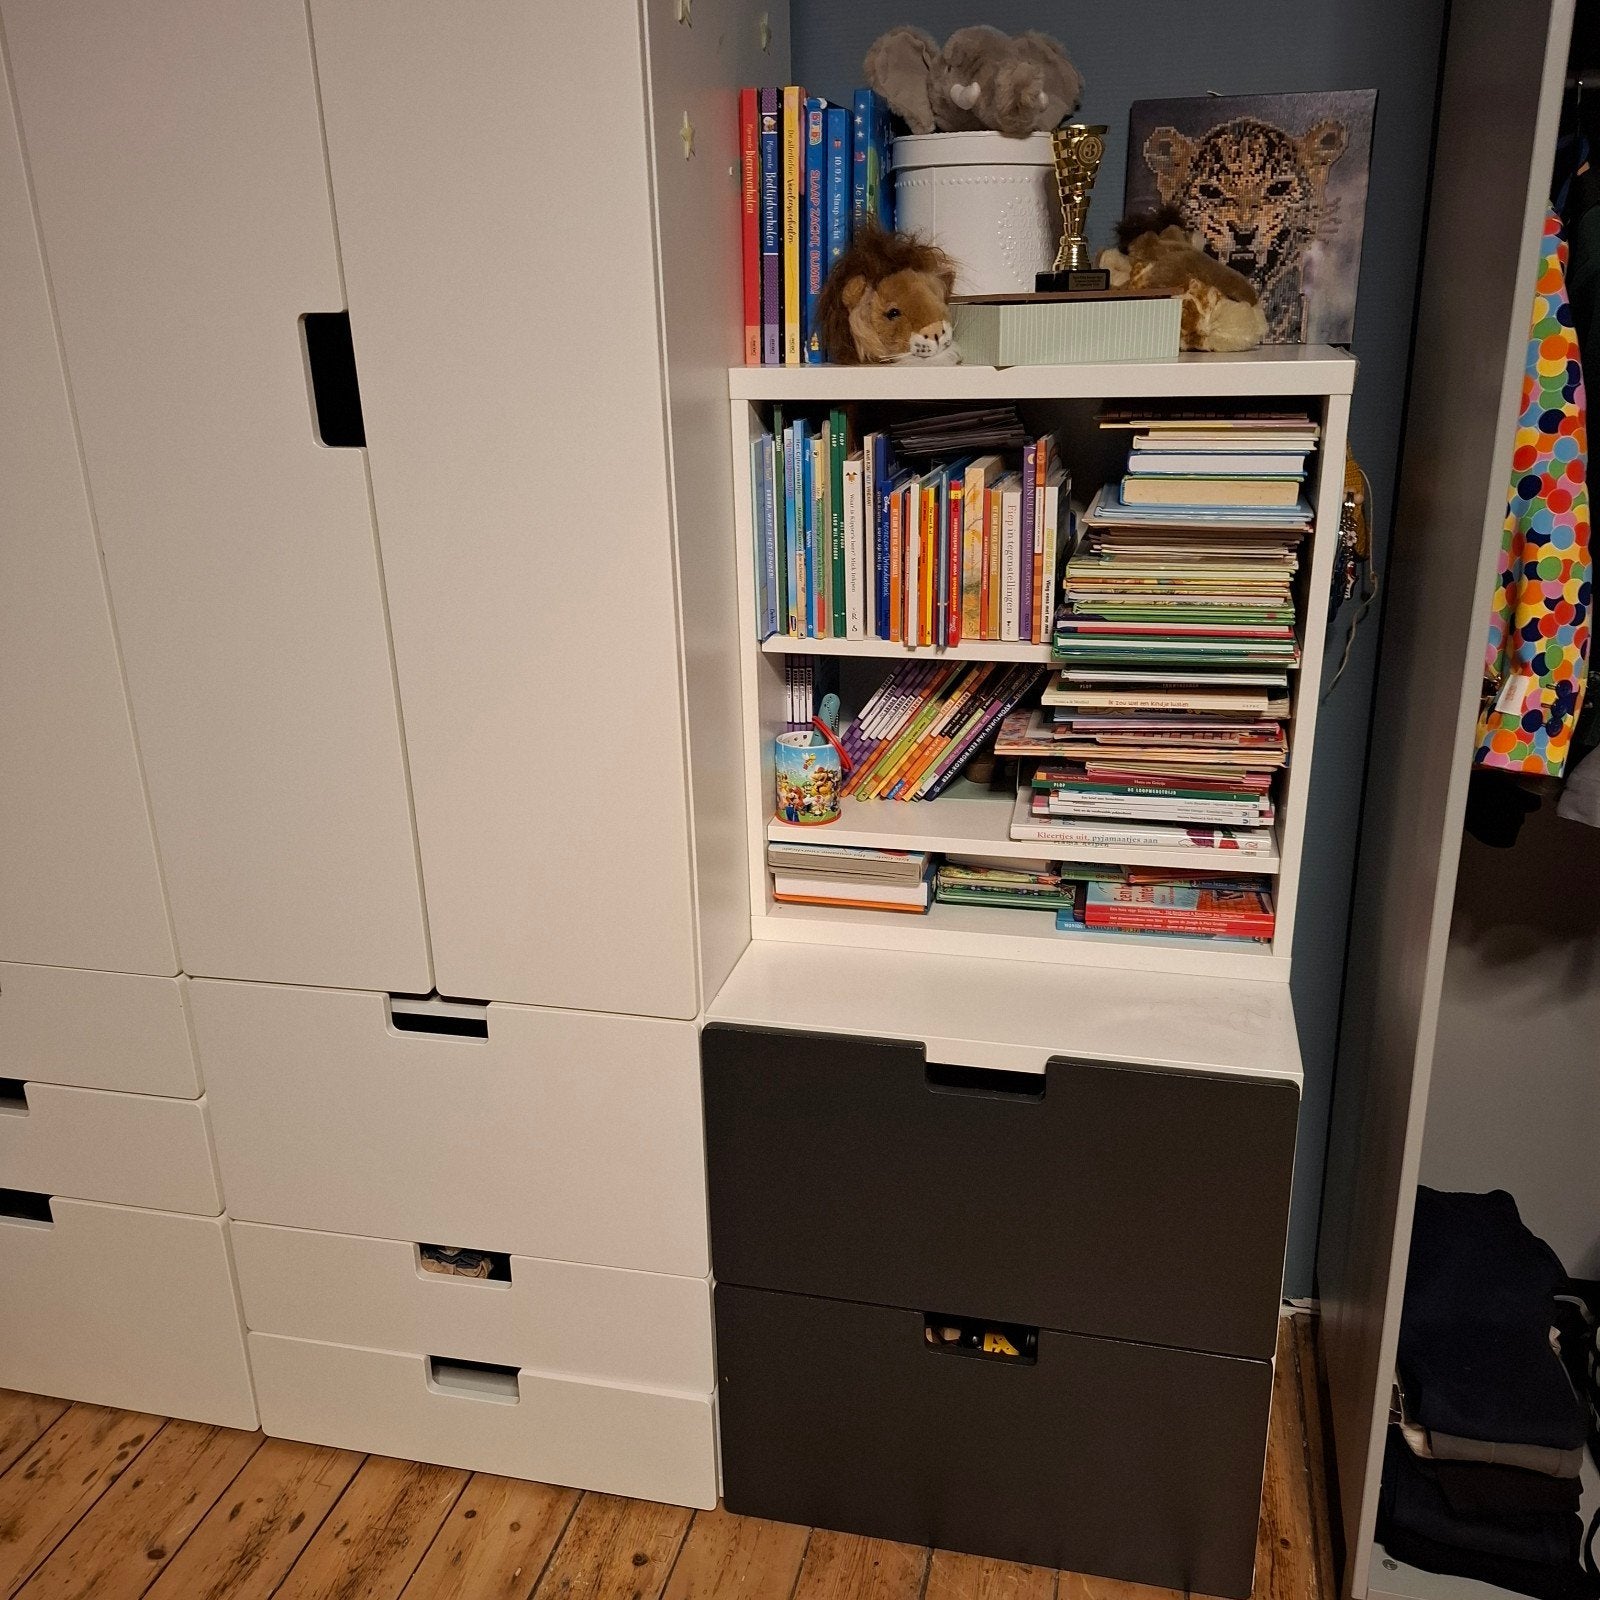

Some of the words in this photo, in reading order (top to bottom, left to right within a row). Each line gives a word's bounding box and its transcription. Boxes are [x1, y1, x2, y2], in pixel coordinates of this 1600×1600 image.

[745, 150, 754, 214] Dierenverhalen
[810, 170, 820, 206] SLAAP
[855, 184, 865, 196] Je
[764, 172, 777, 246] Bedtijdverhalen
[882, 495, 890, 513] Disney
[1026, 478, 1035, 526] MINUUTJE
[1005, 505, 1017, 526] Fiep
[1008, 529, 1016, 540] in
[952, 554, 957, 562] de
[1005, 542, 1016, 614] tegenstellingen
[1044, 580, 1052, 592] Vlieg
[1150, 700, 1169, 708] kindje
[985, 702, 1012, 734] AVONTUREN
[976, 731, 987, 743] VAN
[967, 741, 978, 753] EEN
[940, 750, 970, 783] ROBLOX-STER
[1037, 832, 1073, 841] Kleertjes
[1076, 834, 1090, 842] uit,
[1092, 834, 1140, 844] pyjamaatjes
